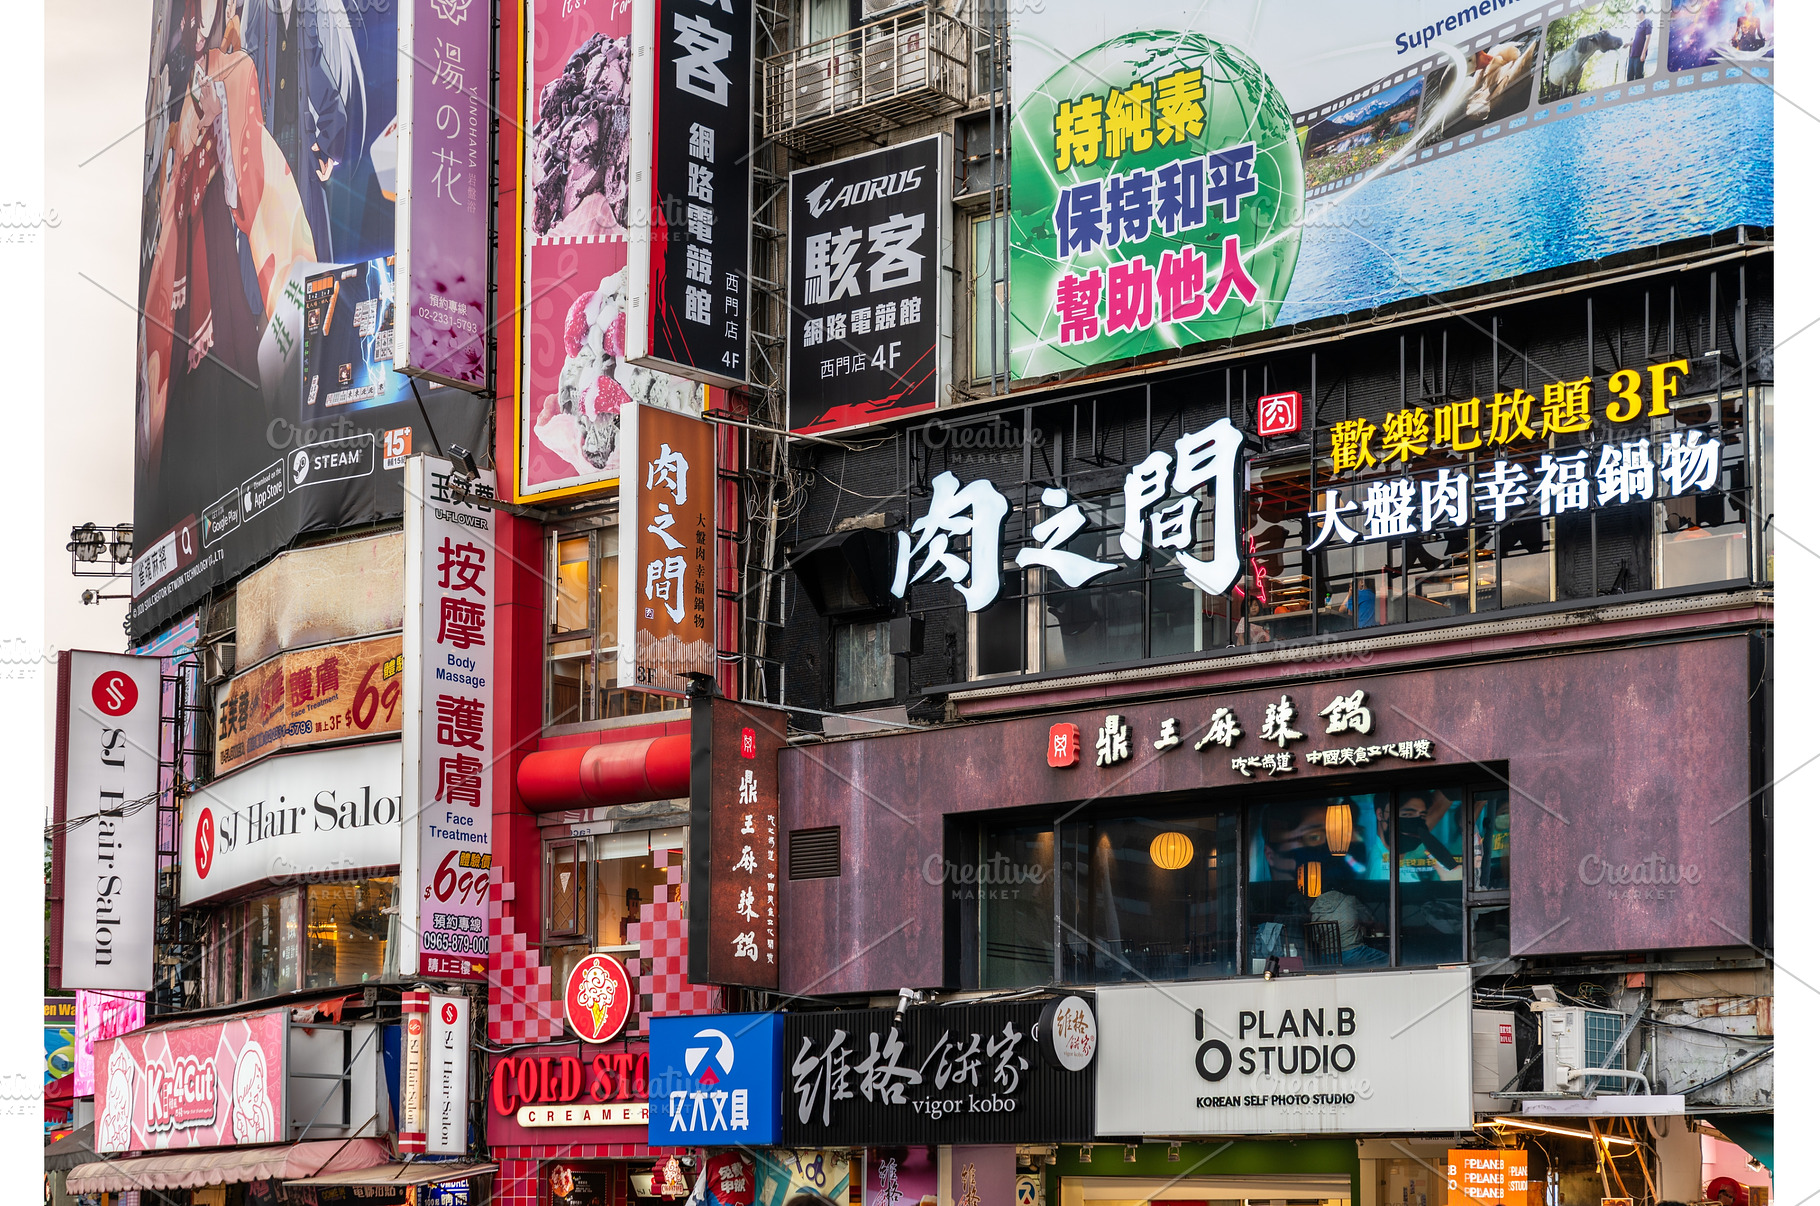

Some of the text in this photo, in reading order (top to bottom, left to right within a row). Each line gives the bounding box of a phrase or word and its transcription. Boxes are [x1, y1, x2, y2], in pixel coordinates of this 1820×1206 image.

[431, 36, 463, 206] 湯の花
[468, 86, 477, 168] YUNOHANA
[1056, 68, 1206, 172] 持純素
[826, 165, 926, 212] AORUS
[1054, 142, 1257, 259] 保持和平
[685, 122, 715, 326] 網路電競館
[803, 212, 927, 306] 駭客
[428, 293, 468, 316] 預約專線
[725, 272, 740, 340] 西門店
[1056, 237, 1259, 344] 幫助他人
[418, 307, 478, 333] 02-2331-5793
[803, 297, 922, 348] 網路電競館
[721, 351, 740, 369] 4F
[820, 341, 901, 379] 西門店 4F
[1330, 359, 1690, 475] 歡樂吧放題 3F
[254, 480, 283, 508] App Store
[890, 417, 1244, 612] 肉之間
[1307, 430, 1722, 553] 大盤肉幸福鍋物
[211, 508, 239, 533] Google Play
[434, 508, 489, 530] U-FLOWER
[645, 443, 689, 624] 肉之間
[436, 536, 486, 649] 按摩
[693, 513, 706, 629] 大盤肉幸福鍋物
[436, 667, 486, 688] Massage
[447, 653, 476, 672] Body
[637, 665, 657, 684] 3F
[291, 693, 339, 718] Face Treatment
[1096, 689, 1374, 767] 鼎王麻辣鍋
[434, 694, 485, 808] 護膚
[219, 810, 241, 855] SJ
[245, 795, 306, 845] Hair
[429, 825, 488, 844] Treatment
[445, 811, 474, 826] Face
[94, 727, 127, 969] SJ Hair Salon
[731, 769, 760, 963] 鼎王麻辣鍋
[433, 913, 482, 932] 預約專線
[428, 958, 471, 975] 請上三樓
[1238, 1007, 1357, 1040] PLAN.B
[1238, 1043, 1356, 1075] STUDIO
[407, 1091, 417, 1124] Salon
[441, 1030, 454, 1147] SJ Hair Salon
[493, 1054, 586, 1116] COLD
[912, 1094, 1016, 1120] vigor kobo
[1197, 1093, 1355, 1109] KOREAN SELF PHOTO STUDIO
[669, 1089, 750, 1132] 久大文具
